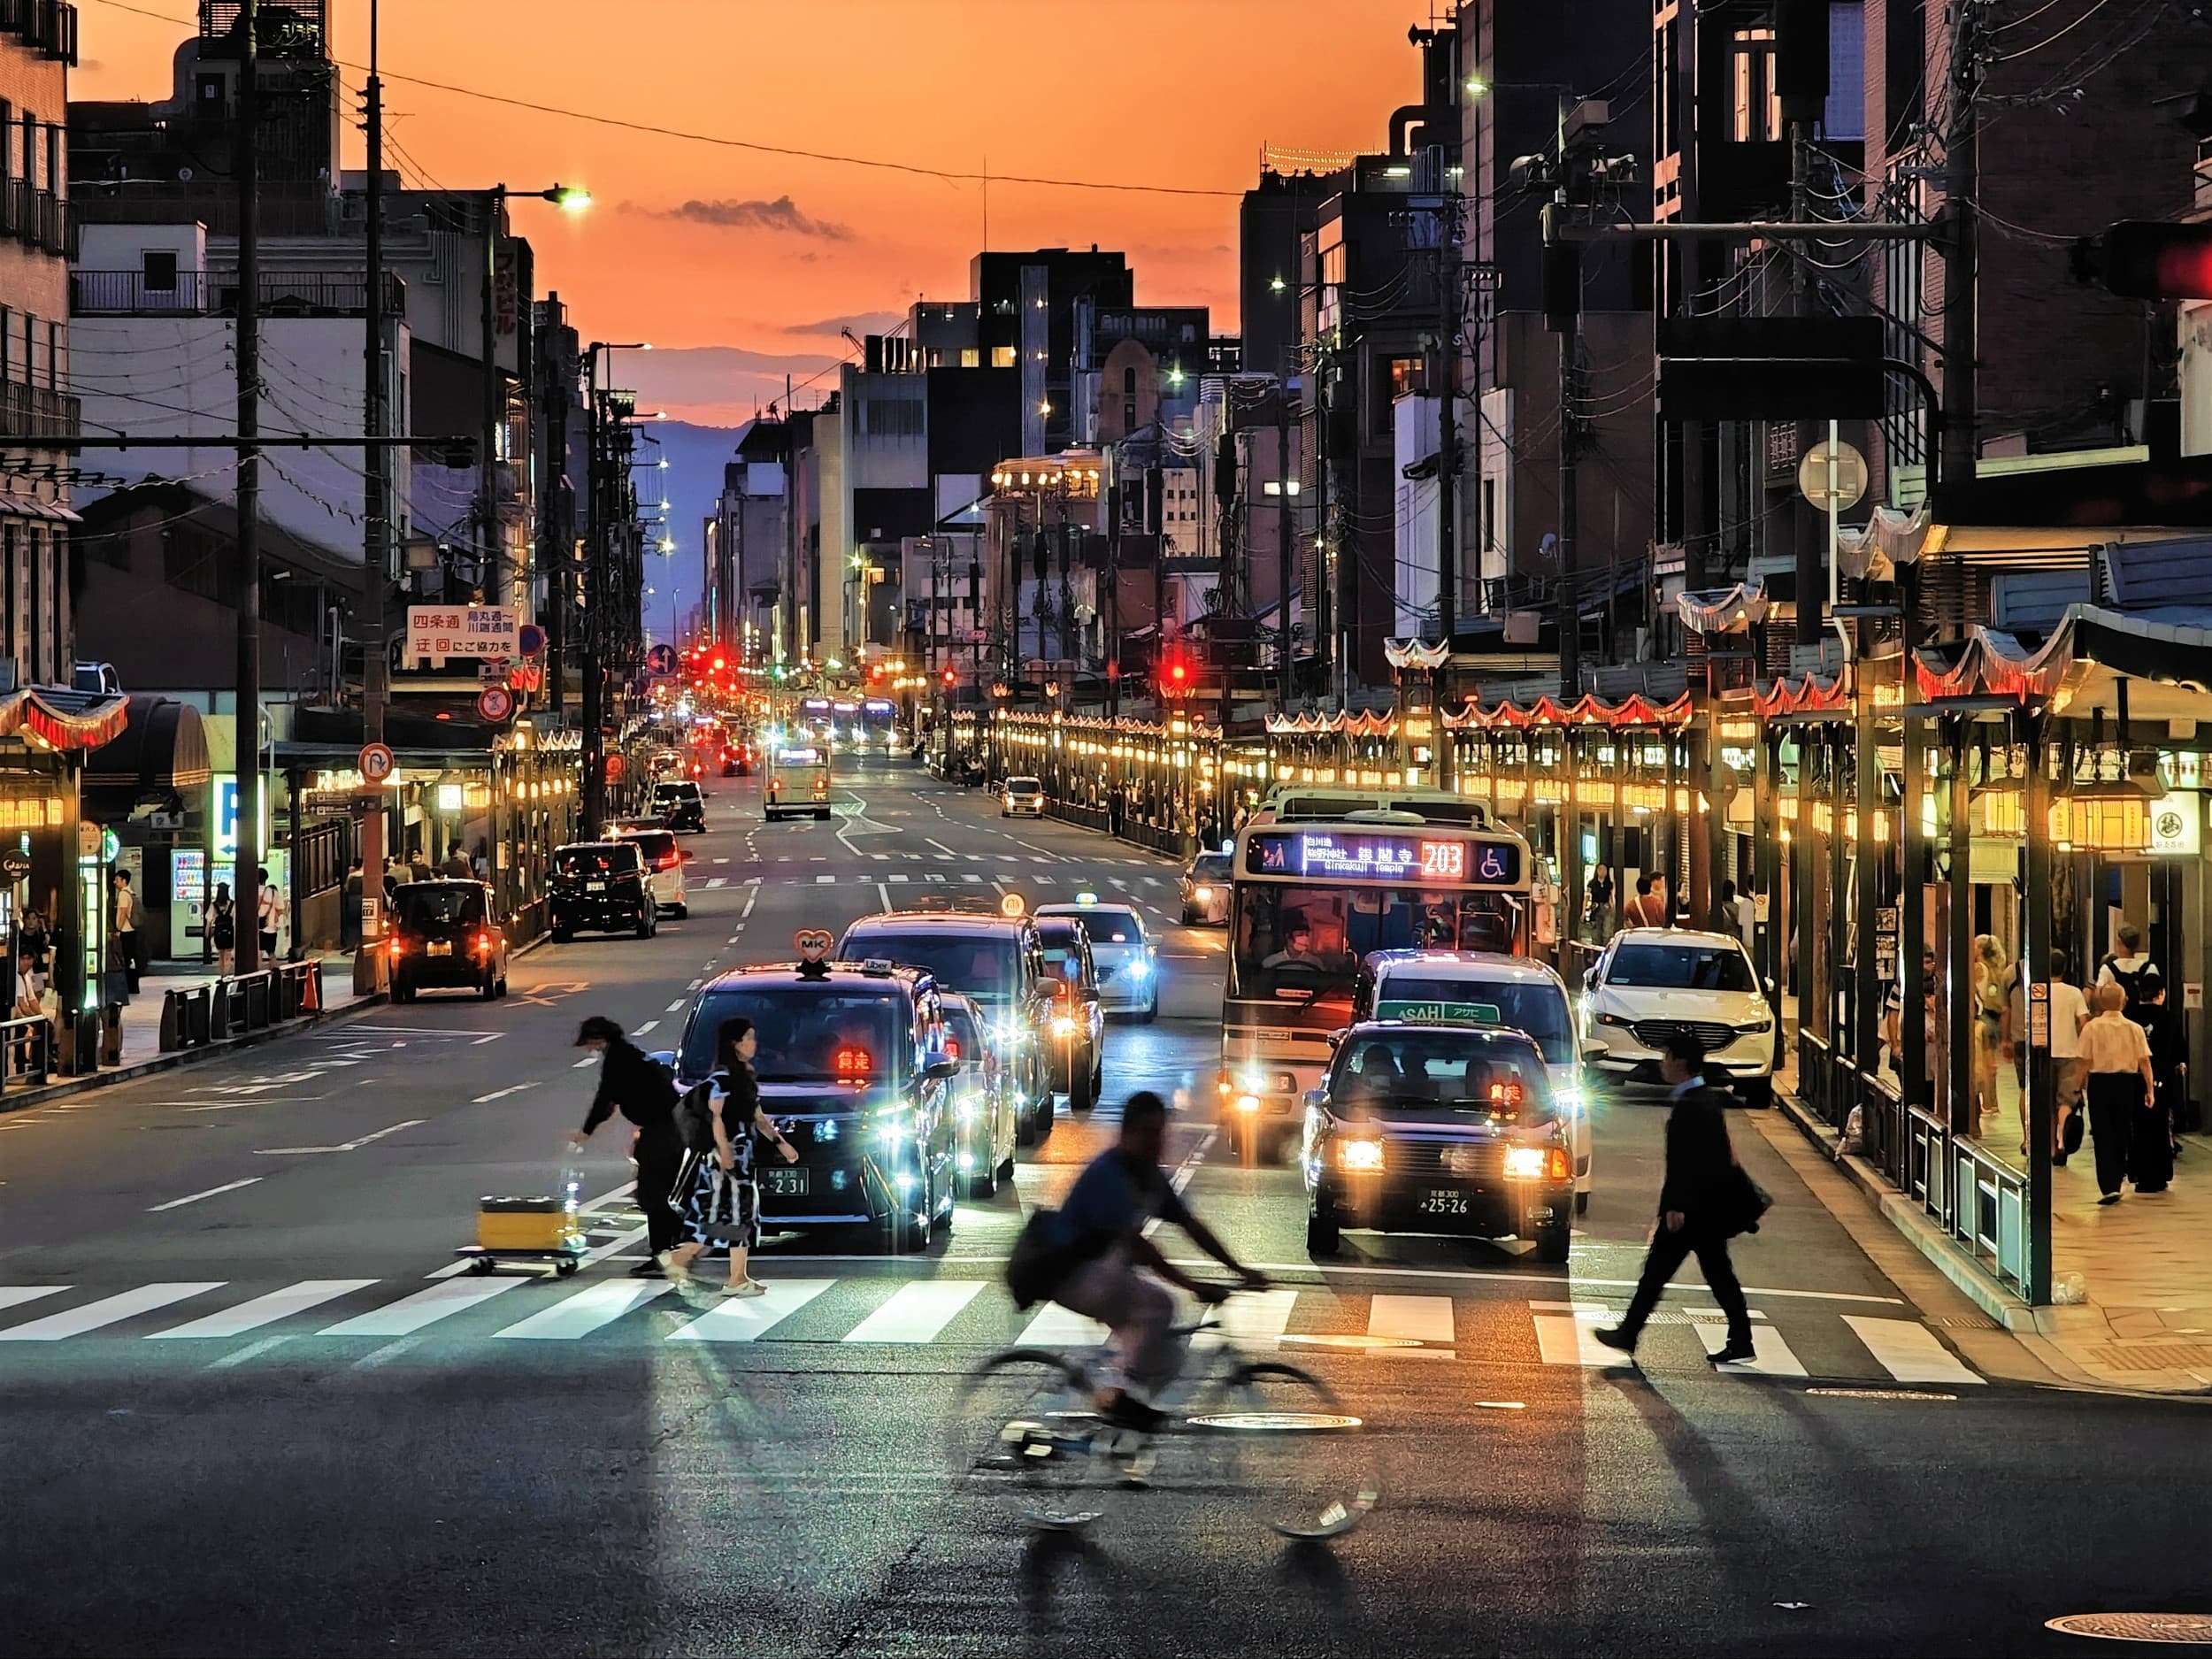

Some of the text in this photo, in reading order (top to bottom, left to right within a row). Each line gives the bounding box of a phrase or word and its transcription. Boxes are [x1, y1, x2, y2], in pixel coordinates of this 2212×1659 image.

[413, 615, 460, 629] 四条通
[1425, 844, 1462, 874] 203
[802, 940, 825, 949] MK
[865, 960, 887, 970] Uber
[1428, 1198, 1468, 1214] 25-26
